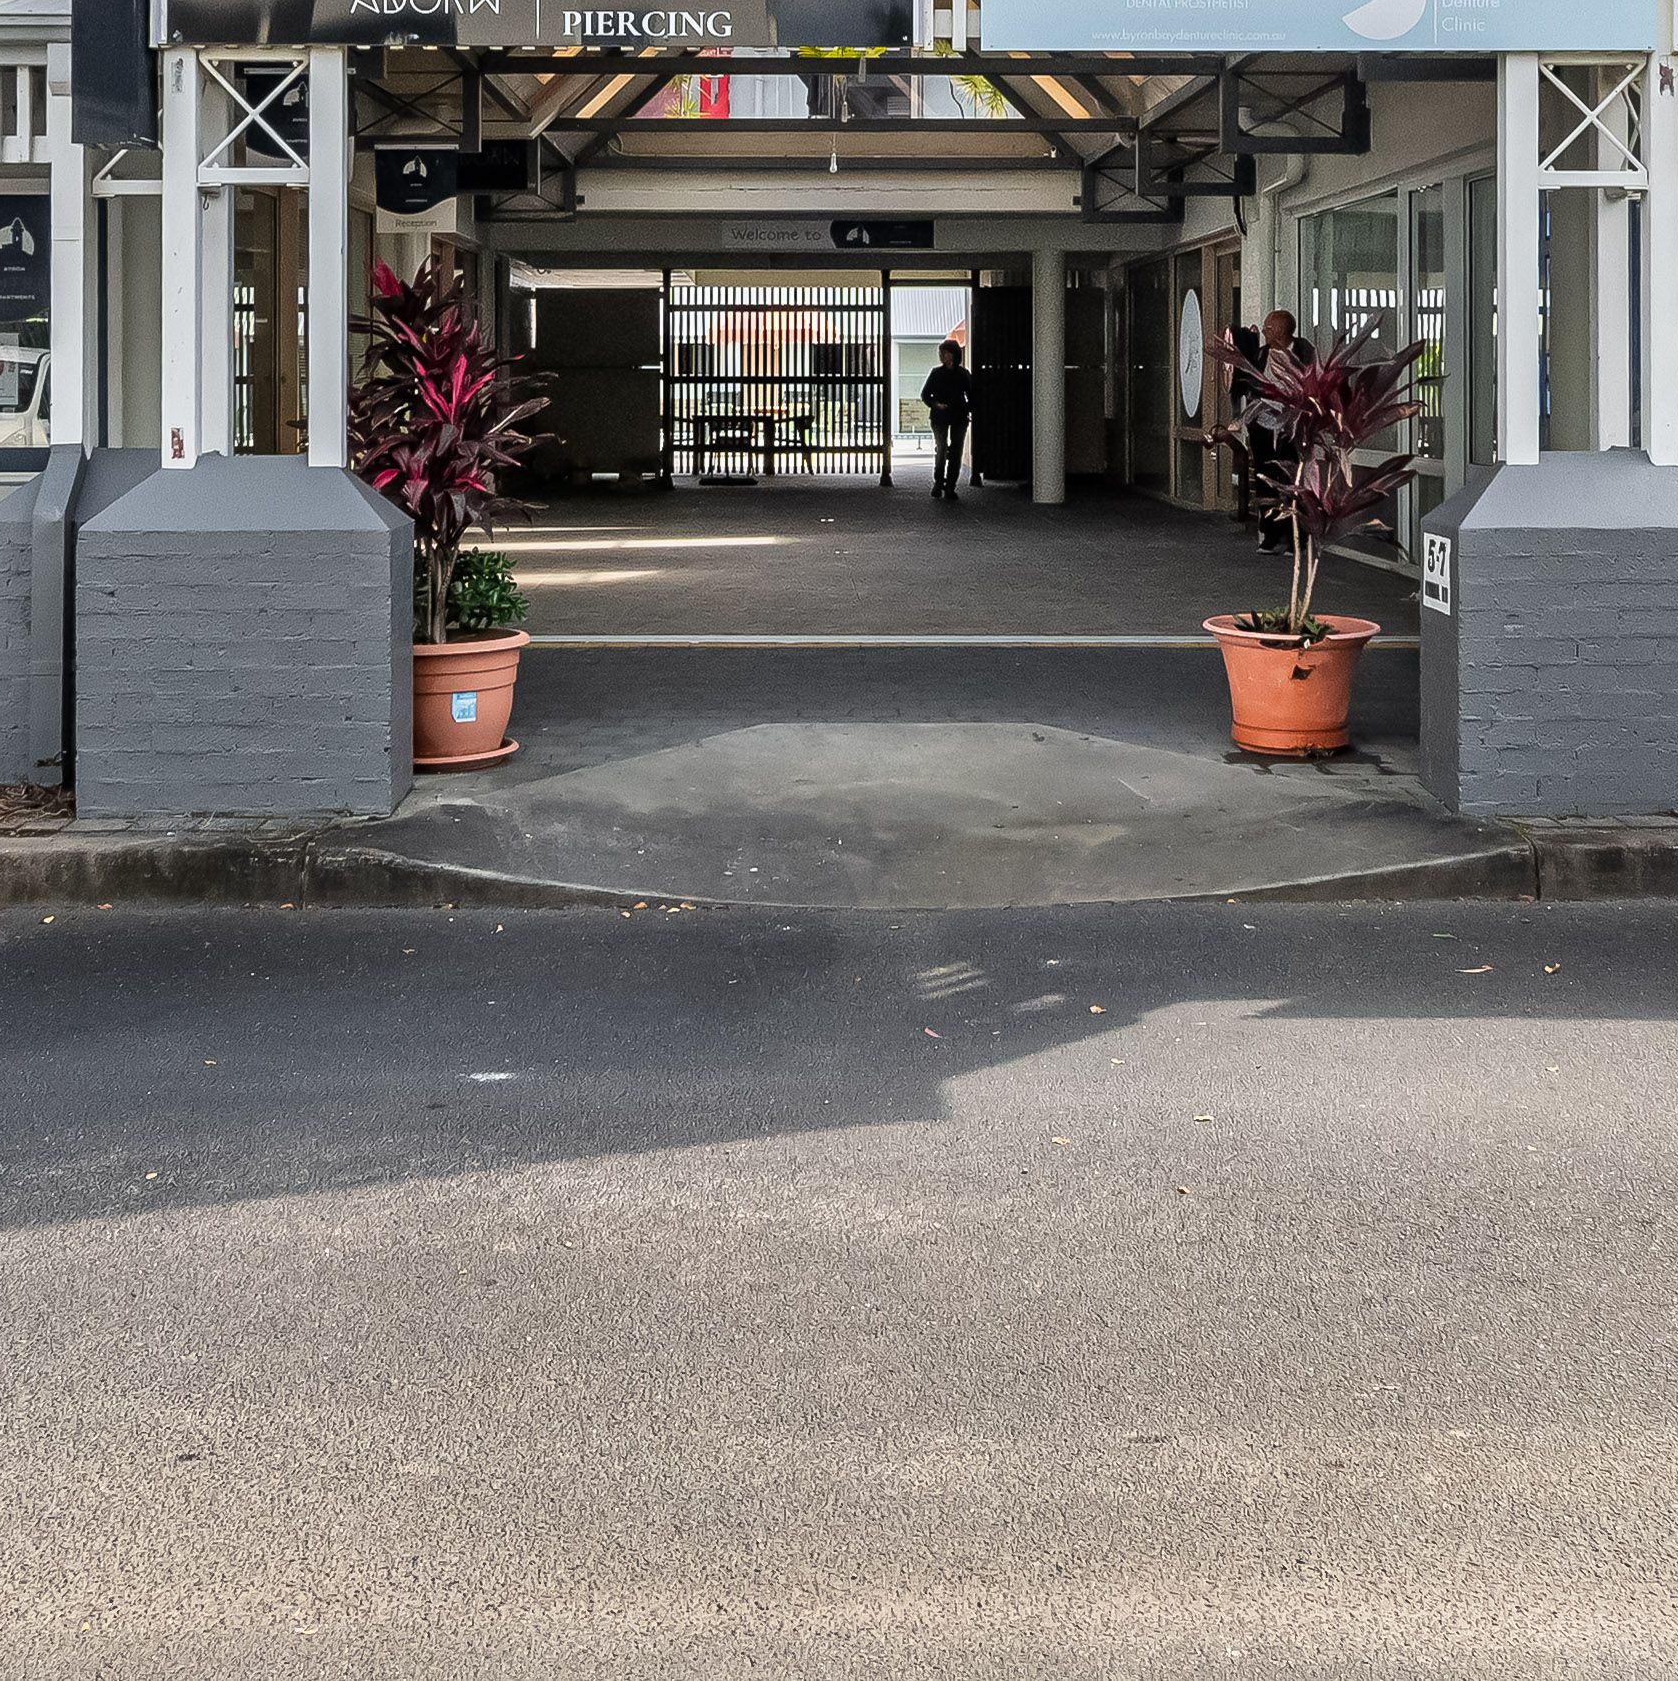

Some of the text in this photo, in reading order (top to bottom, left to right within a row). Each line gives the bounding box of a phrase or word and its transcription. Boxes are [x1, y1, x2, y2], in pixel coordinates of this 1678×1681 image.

[562, 10, 733, 38] PIERCING
[1441, 16, 1486, 32] Clinic
[1091, 28, 1287, 43] www.byronbaydentureclinic.com.au
[395, 218, 438, 229] Reception
[731, 228, 821, 241] Welcome to
[1427, 538, 1447, 577] 5-7
